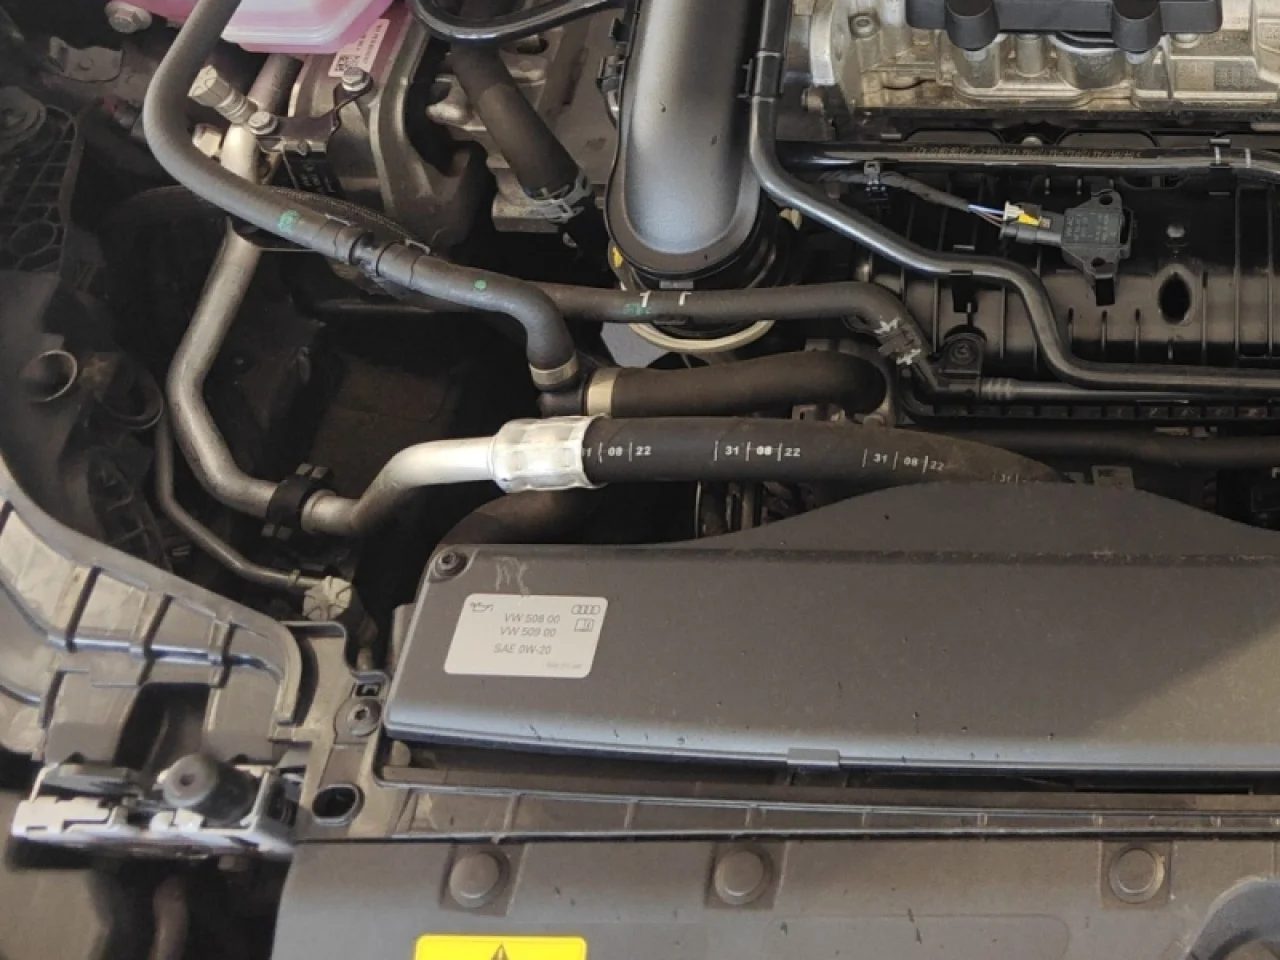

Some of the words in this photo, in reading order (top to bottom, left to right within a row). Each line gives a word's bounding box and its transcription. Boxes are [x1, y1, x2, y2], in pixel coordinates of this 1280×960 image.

[635, 446, 652, 456] 22
[724, 445, 739, 455] 31
[784, 447, 801, 457] 22
[872, 453, 887, 464] 31
[929, 460, 944, 471] 22
[504, 613, 524, 623] VW
[547, 615, 561, 624] 00
[500, 626, 520, 636] VW
[520, 627, 542, 637] 509
[543, 628, 557, 638] 00
[493, 643, 517, 654] SAE
[518, 644, 552, 655] 0W-20
